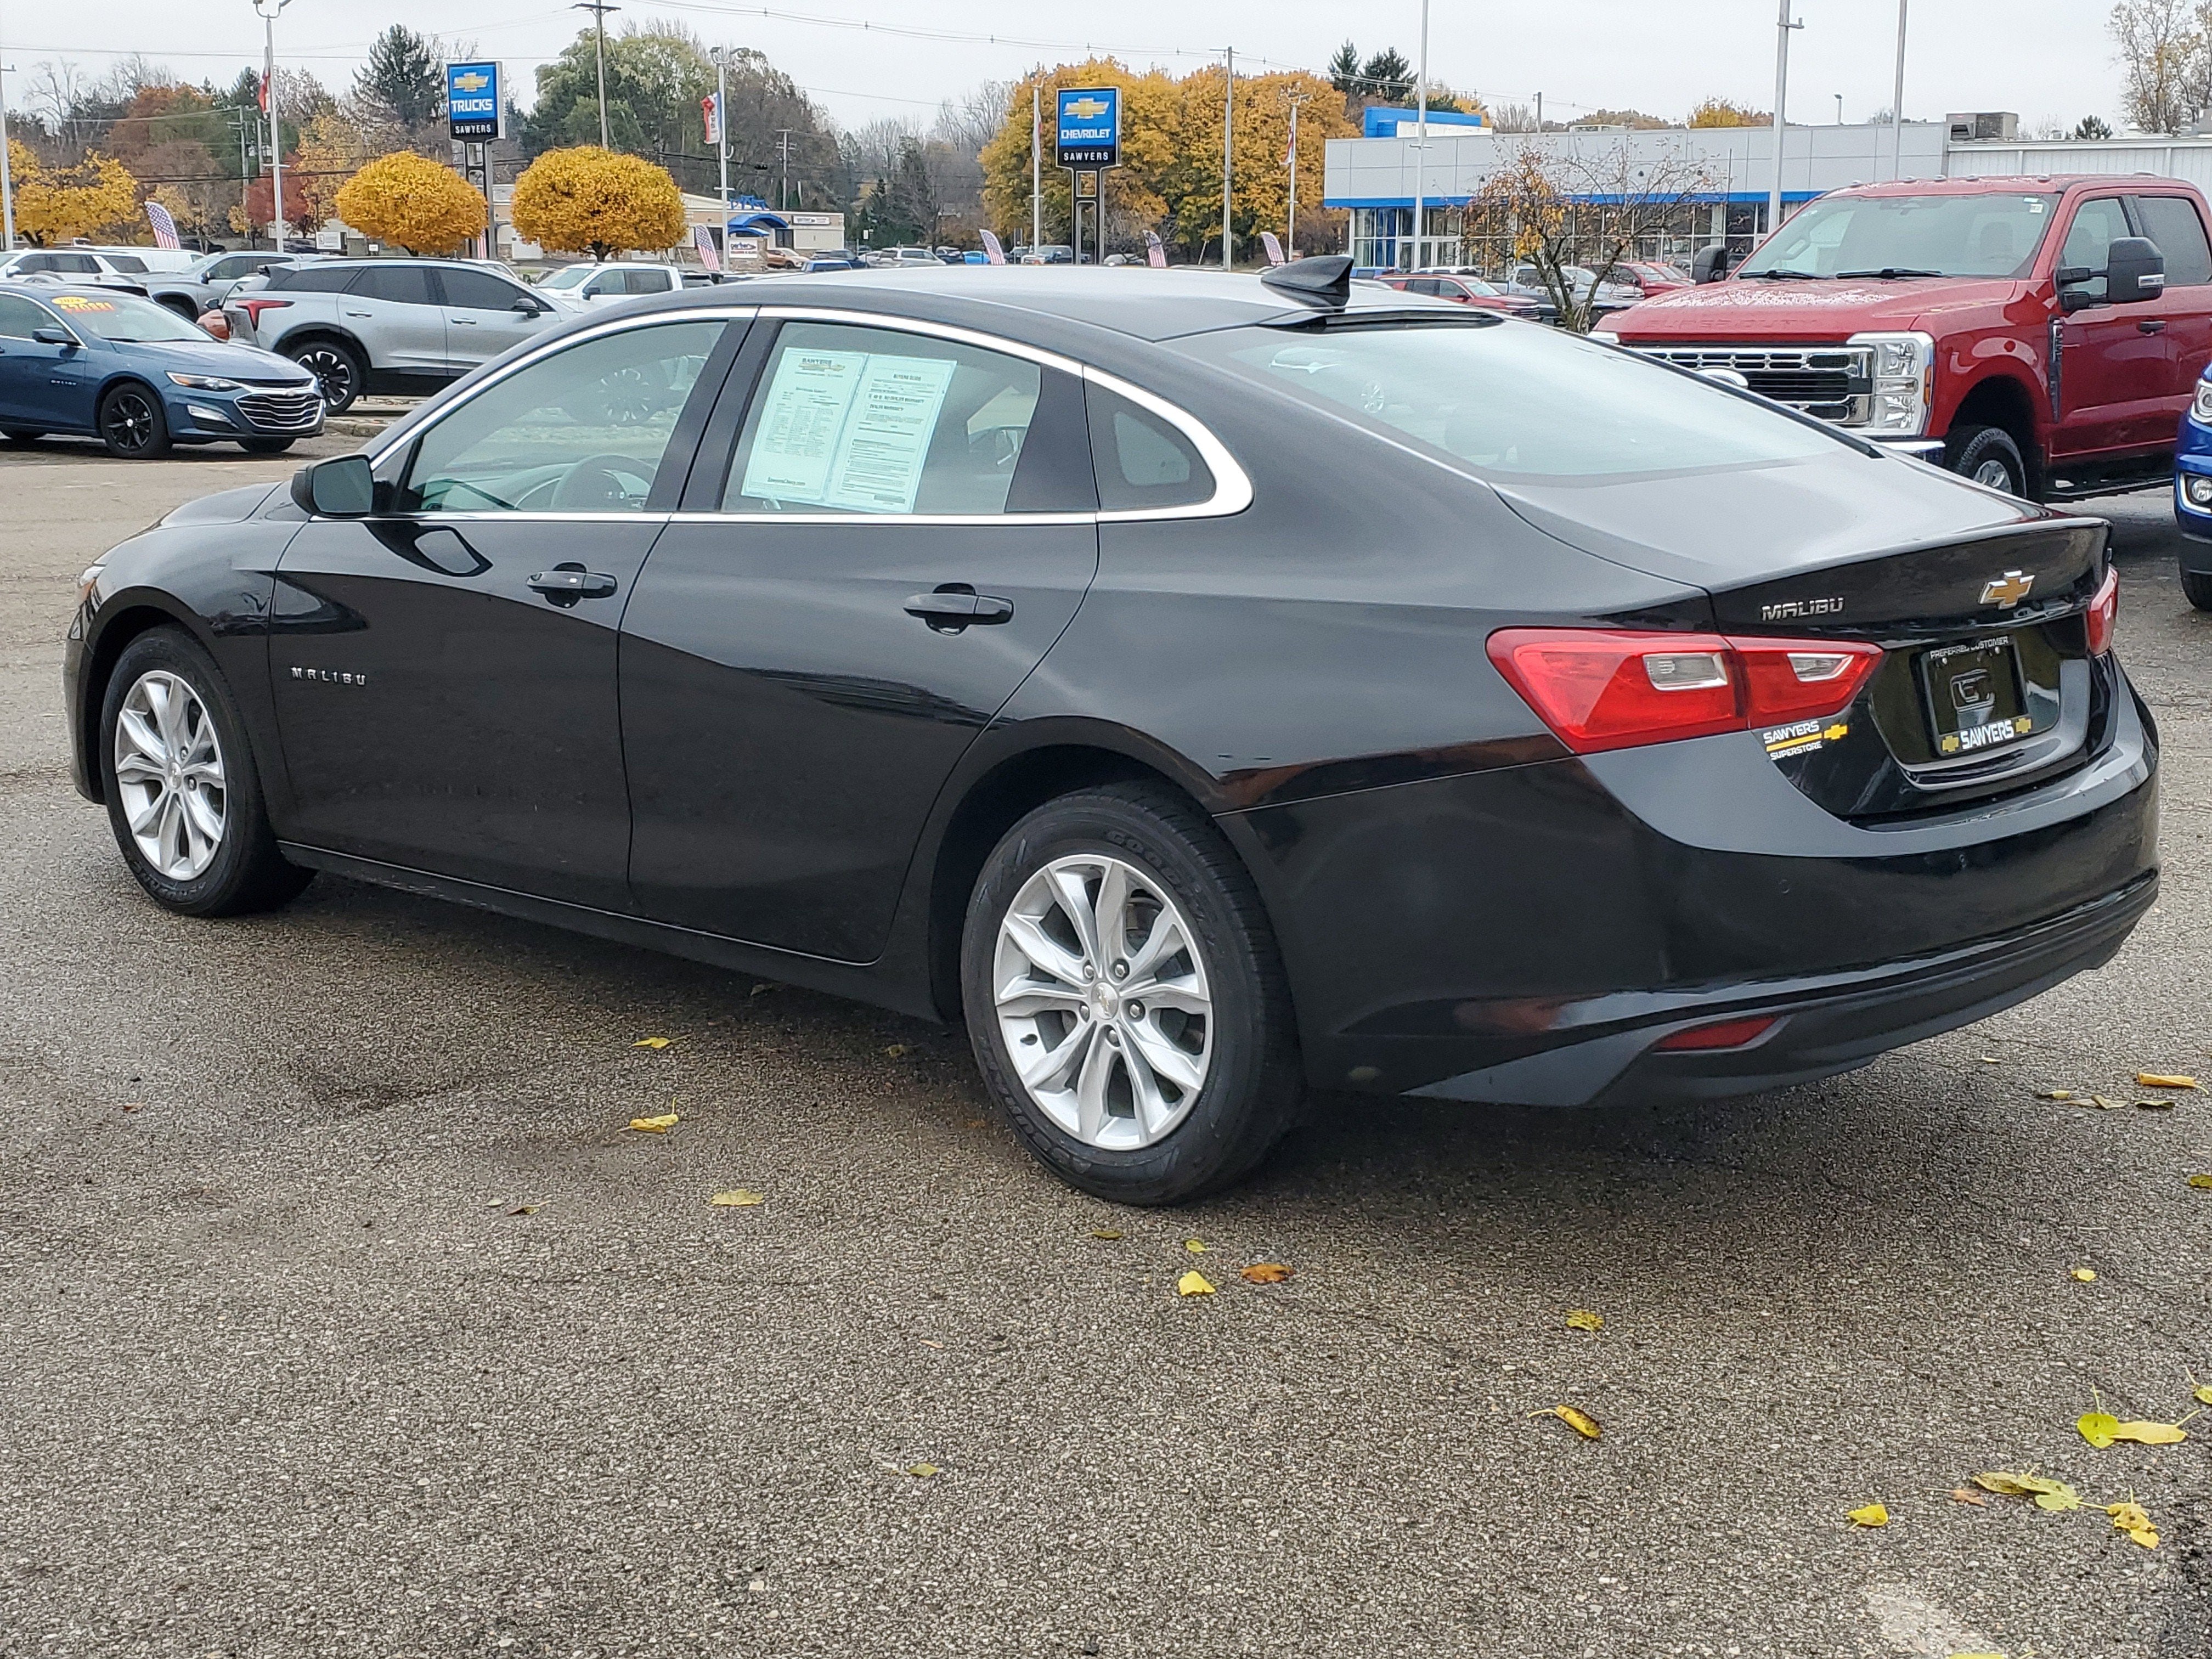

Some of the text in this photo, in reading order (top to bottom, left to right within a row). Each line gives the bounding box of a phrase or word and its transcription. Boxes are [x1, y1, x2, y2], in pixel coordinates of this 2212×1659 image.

[450, 99, 493, 112] TRUCKS
[455, 124, 491, 134] SAWYERS
[1060, 128, 1111, 139] CHEVROLET
[1063, 151, 1109, 161] SAWYERS
[1761, 597, 1844, 621] MALIBU
[291, 667, 366, 686] MALIBU
[1763, 720, 1820, 744] SAWYERS
[1960, 720, 2014, 749] SAWYERS
[1770, 741, 1823, 760] SUPERSTORE
